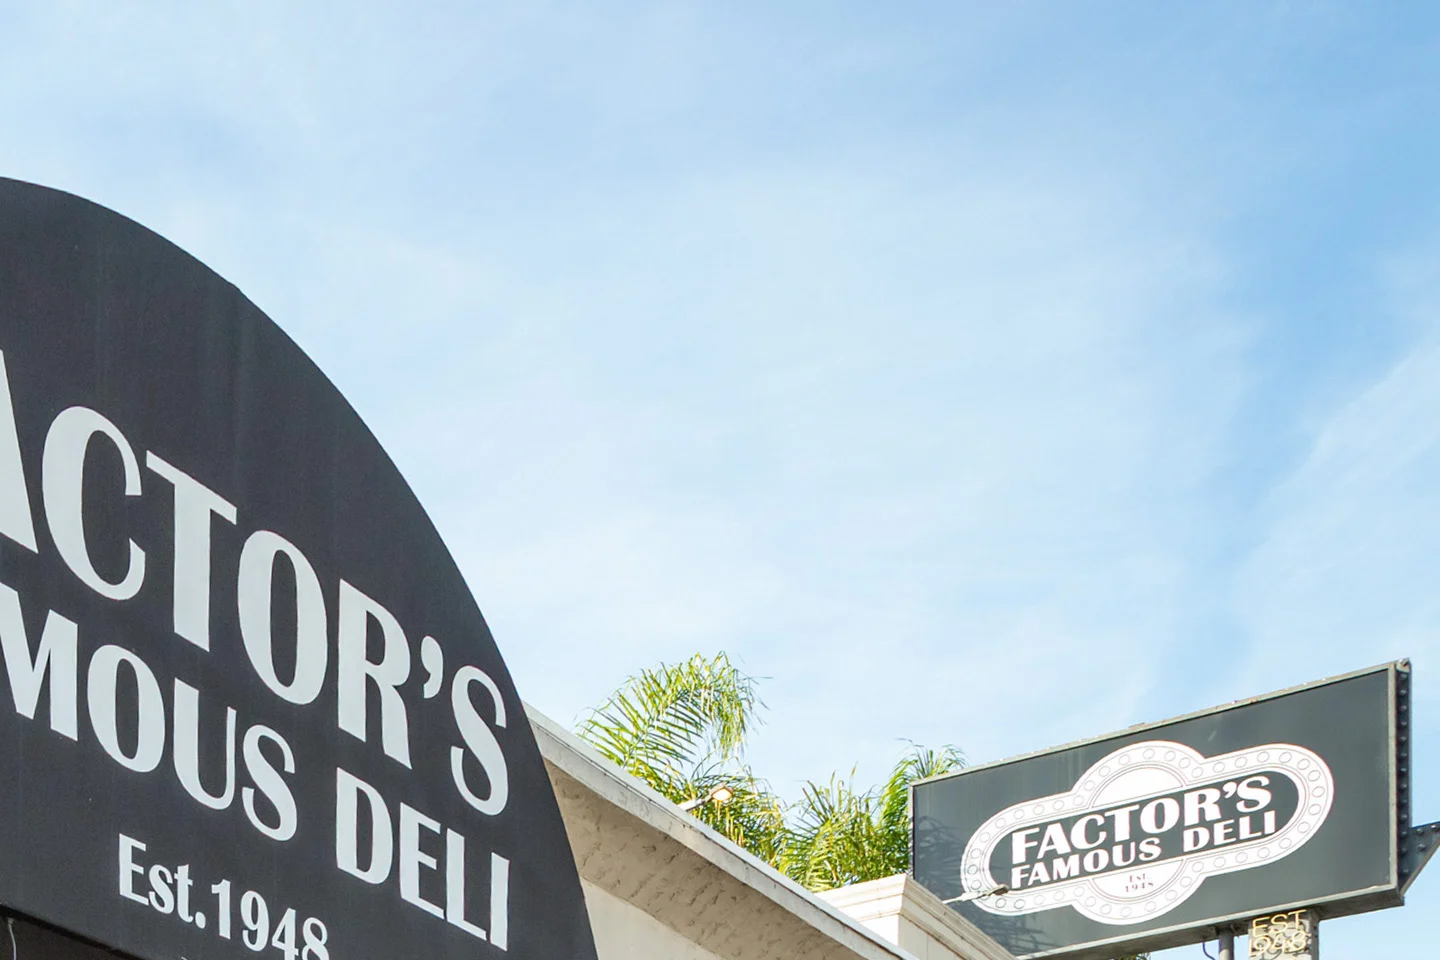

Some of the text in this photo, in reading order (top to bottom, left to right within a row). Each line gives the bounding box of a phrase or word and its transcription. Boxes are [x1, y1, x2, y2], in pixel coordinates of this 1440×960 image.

[335, 767, 509, 950] DELI
[1011, 810, 1276, 889] FAMOUS DELI
[1012, 776, 1271, 864] FACTOR'S
